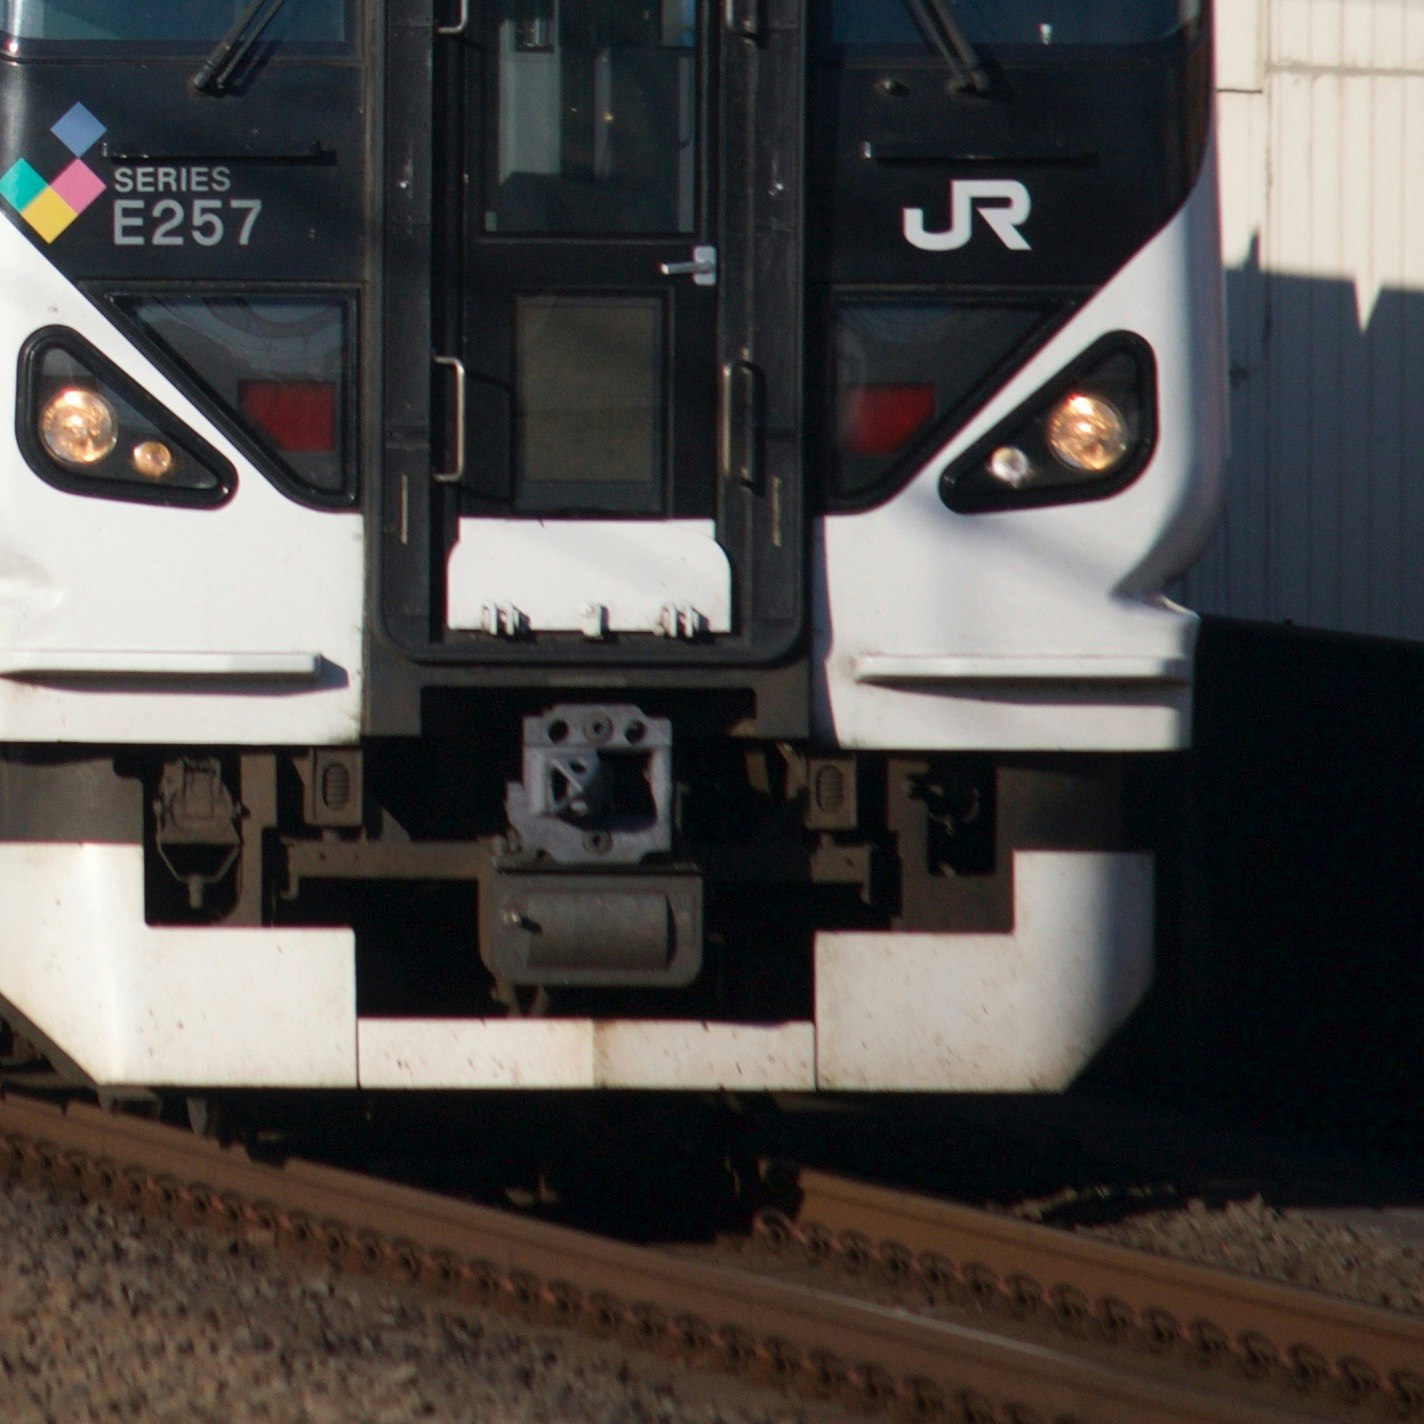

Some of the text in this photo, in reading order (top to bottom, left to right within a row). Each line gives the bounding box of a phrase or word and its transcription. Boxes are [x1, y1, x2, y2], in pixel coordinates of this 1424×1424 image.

[113, 166, 231, 193] SERIES
[113, 199, 262, 246] E257
[903, 179, 1031, 251] JR
